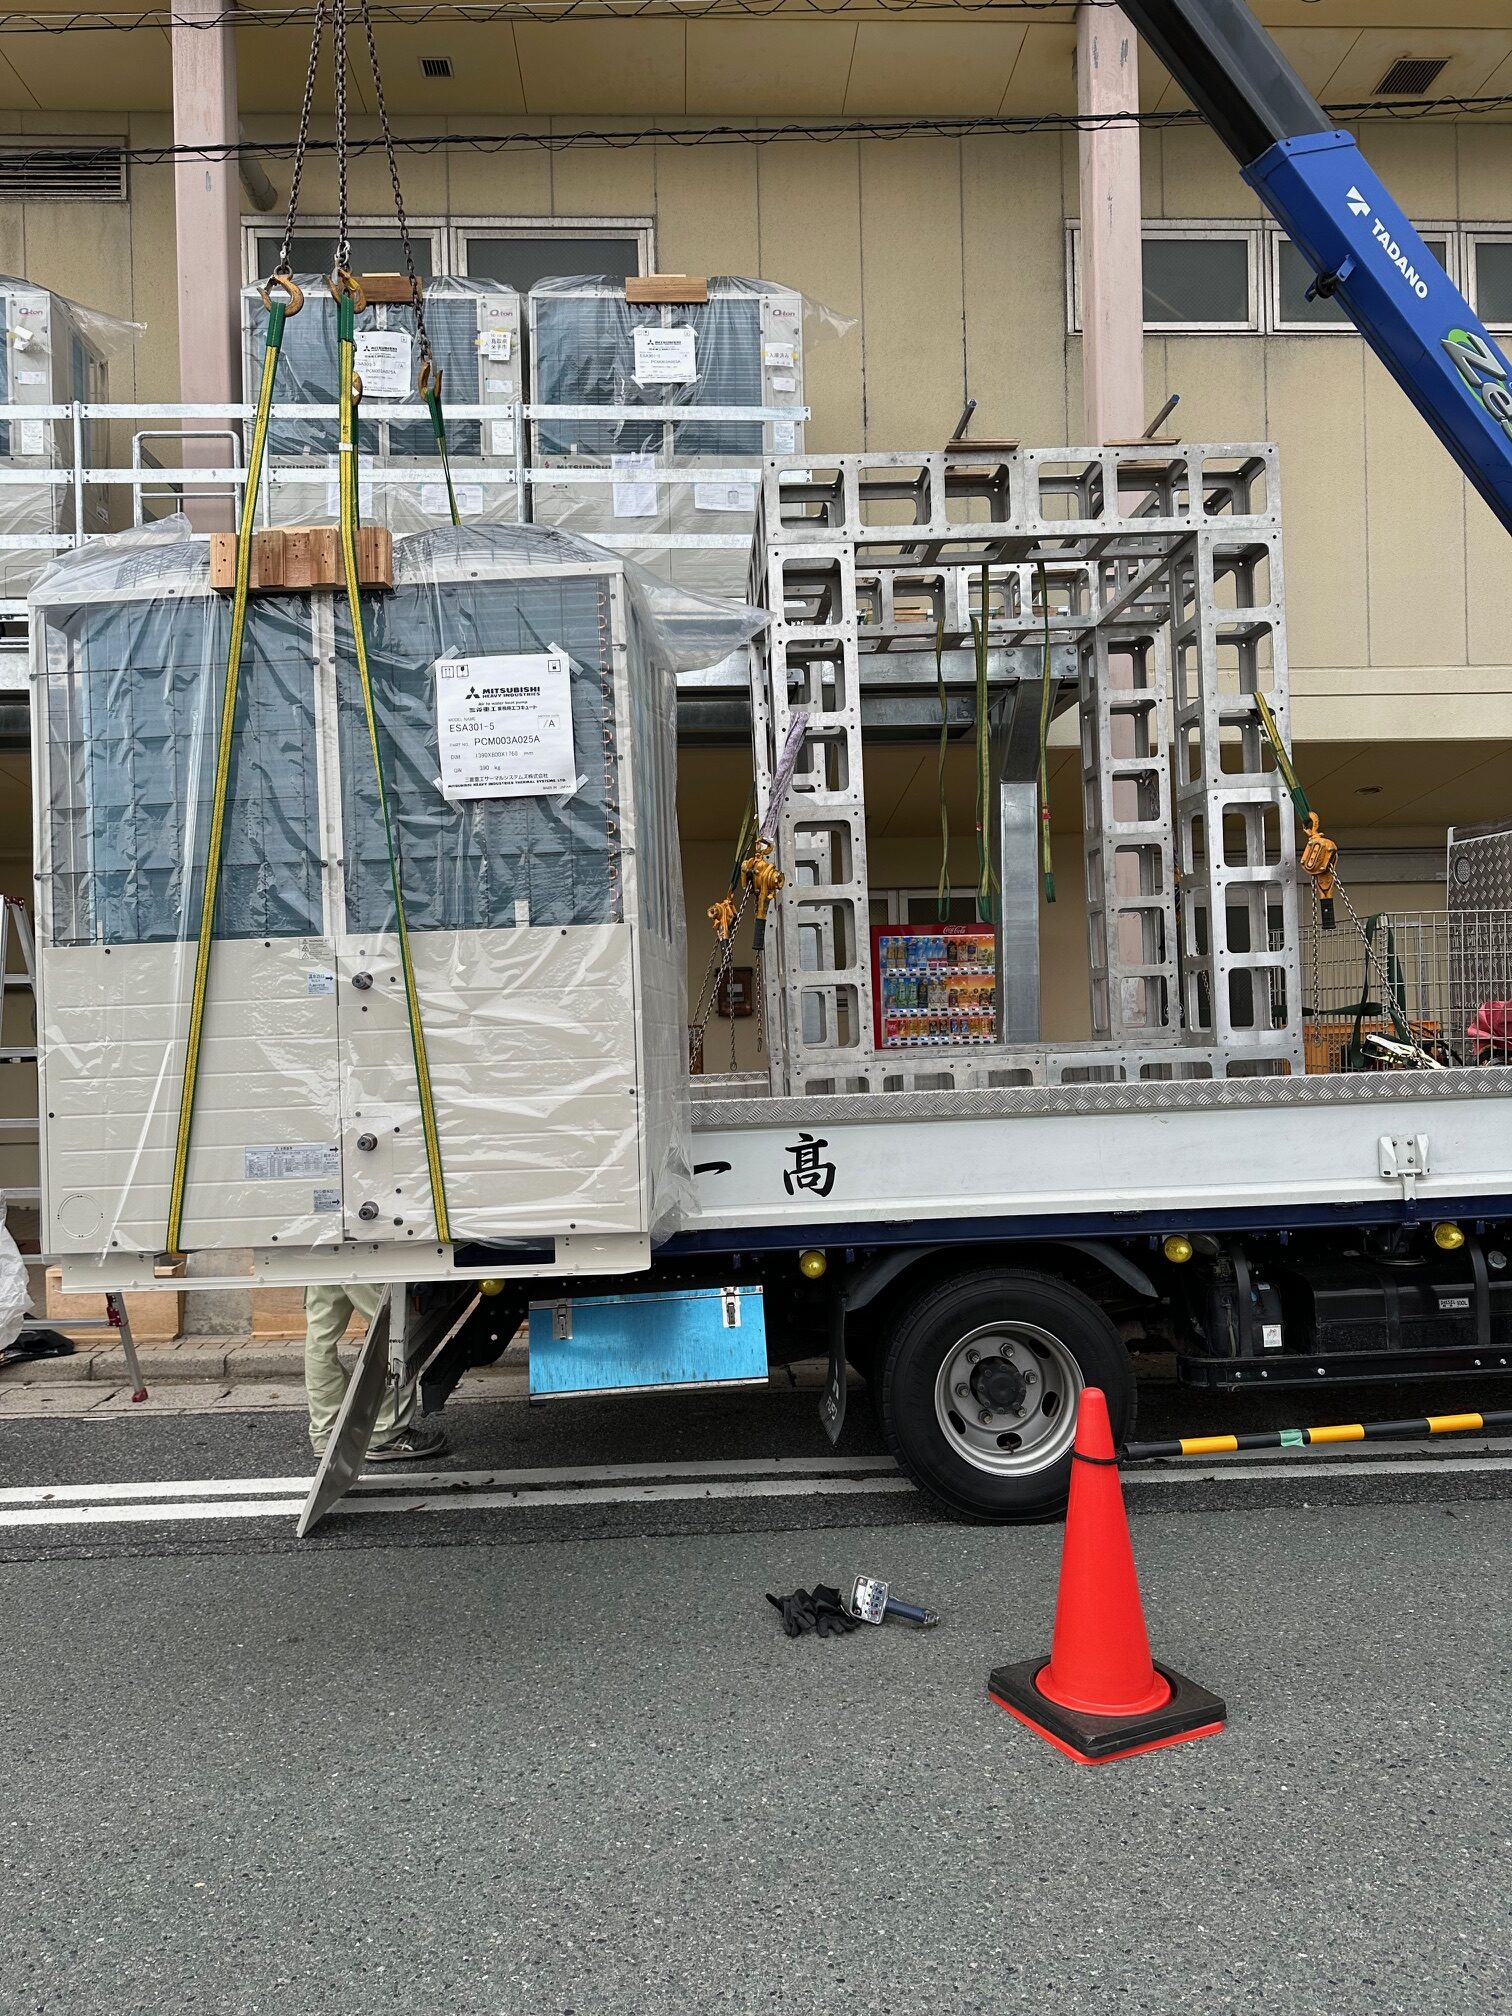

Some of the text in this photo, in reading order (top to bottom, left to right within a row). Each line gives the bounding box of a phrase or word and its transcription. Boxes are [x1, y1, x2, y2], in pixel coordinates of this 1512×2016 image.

[1372, 218, 1428, 298] TADANO
[482, 686, 540, 694] MITSUBISHI
[449, 722, 495, 733] ESA301-5
[474, 735, 541, 747] PCM003A025A
